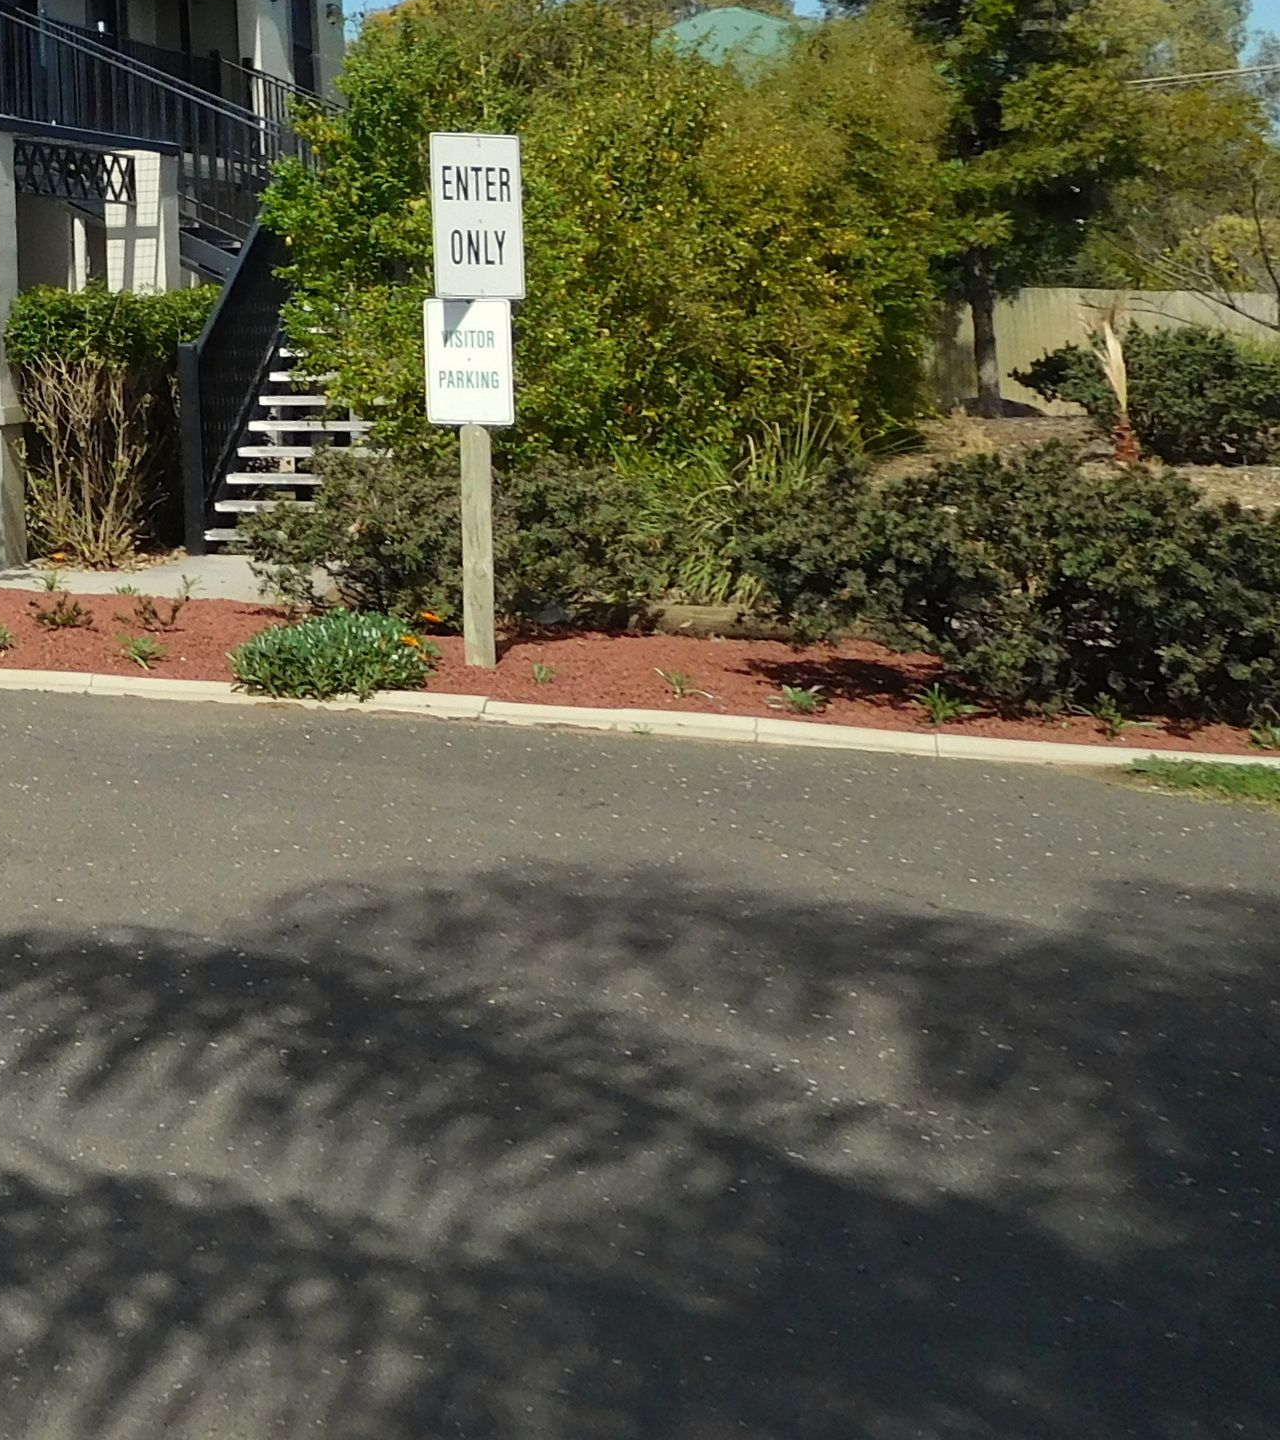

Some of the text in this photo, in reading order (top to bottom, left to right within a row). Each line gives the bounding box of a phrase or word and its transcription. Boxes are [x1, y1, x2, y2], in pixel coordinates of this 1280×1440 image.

[442, 165, 511, 202] ENTER
[451, 229, 506, 266] ONLY
[441, 330, 495, 348] VISITOR
[439, 370, 500, 389] PARKING
